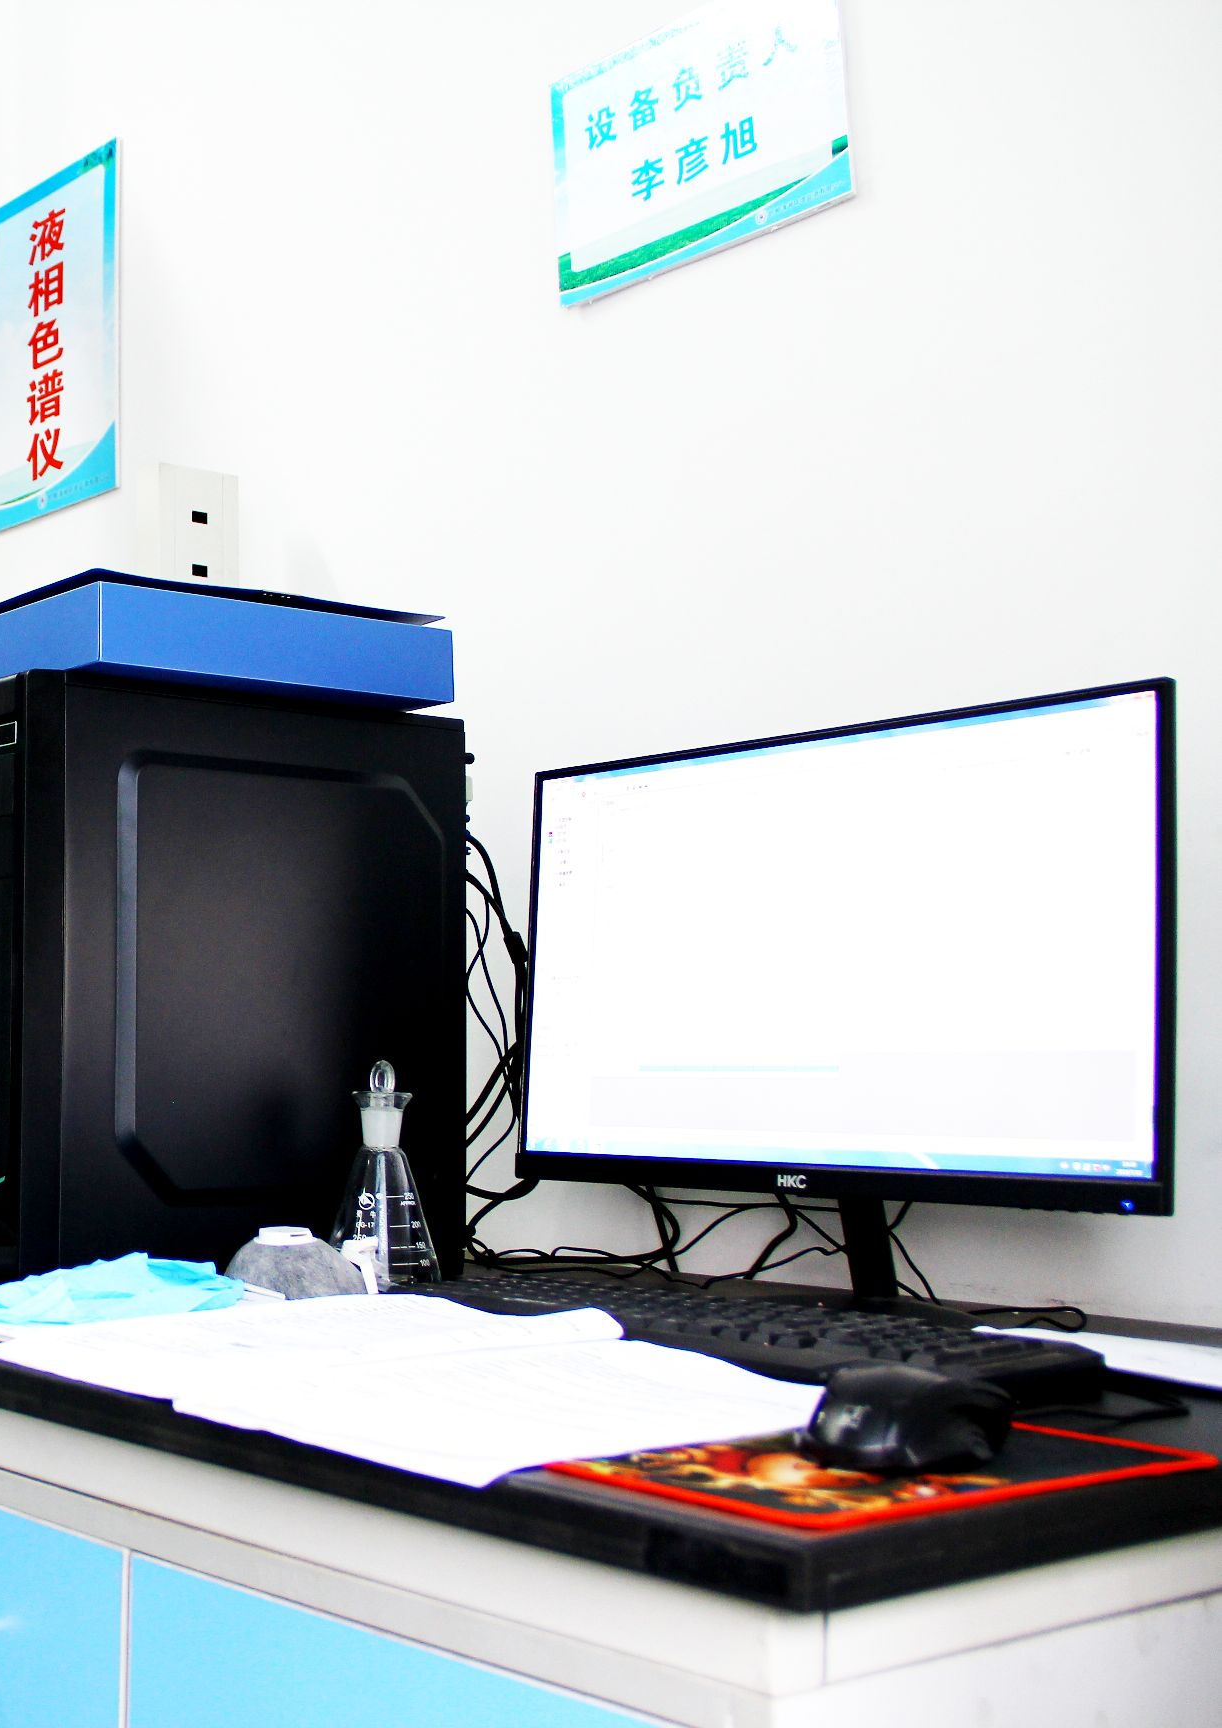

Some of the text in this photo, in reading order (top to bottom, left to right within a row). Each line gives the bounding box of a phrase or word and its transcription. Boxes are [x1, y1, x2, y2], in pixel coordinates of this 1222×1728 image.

[631, 116, 758, 202] 李彦旭
[26, 207, 67, 481] 液相色谱仪
[777, 1174, 807, 1189] HKC
[415, 1241, 426, 1249] 150
[419, 1259, 430, 1267] 100
